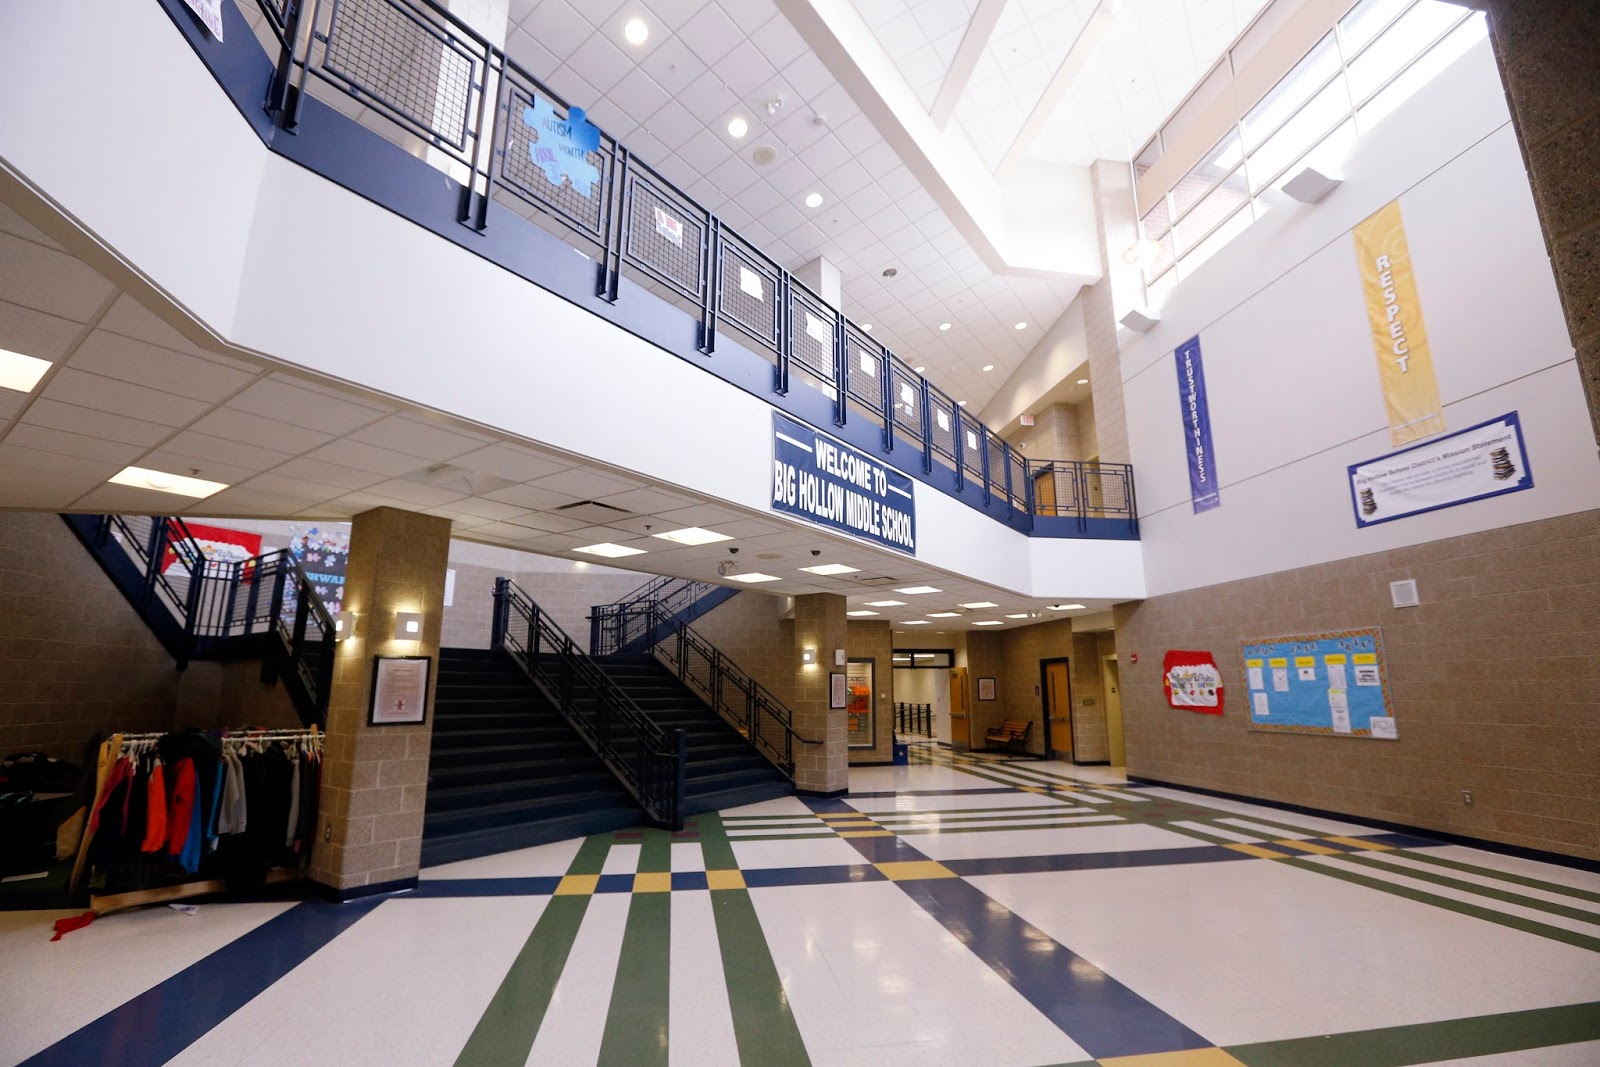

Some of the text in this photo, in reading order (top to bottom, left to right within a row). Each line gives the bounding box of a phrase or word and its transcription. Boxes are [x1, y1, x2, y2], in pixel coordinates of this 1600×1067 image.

[542, 116, 572, 140] AUTISM
[559, 143, 584, 160] MONTH
[1376, 254, 1409, 373] RESPECT
[1184, 350, 1206, 483] TRUSTWORTHINESS
[815, 438, 887, 497] WELCOME TO
[1388, 466, 1411, 476] School
[1442, 447, 1471, 460] Mission
[1472, 434, 1512, 451] Statement
[774, 460, 914, 548] BIG HOLLOW MIDDLE SCHOOL
